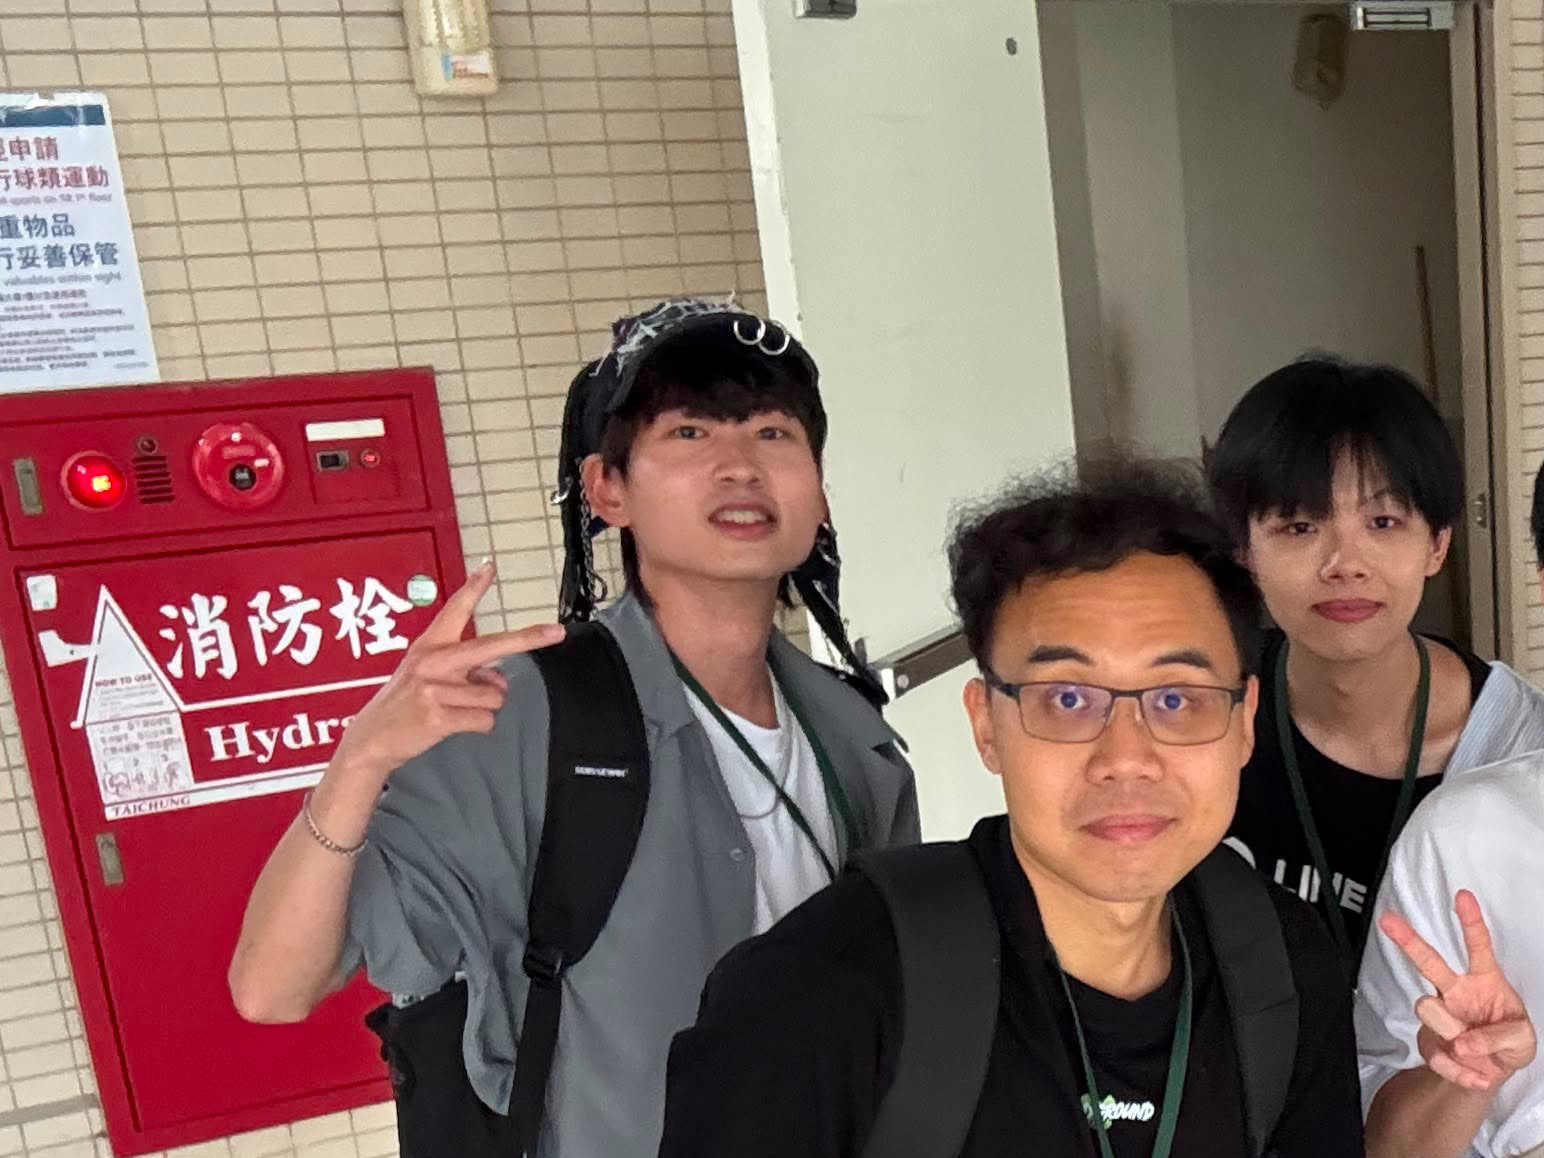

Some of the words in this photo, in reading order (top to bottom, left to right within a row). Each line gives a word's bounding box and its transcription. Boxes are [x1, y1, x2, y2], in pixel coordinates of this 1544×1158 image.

[158, 576, 414, 680] 消防栓
[111, 795, 191, 817] TAICHUNG
